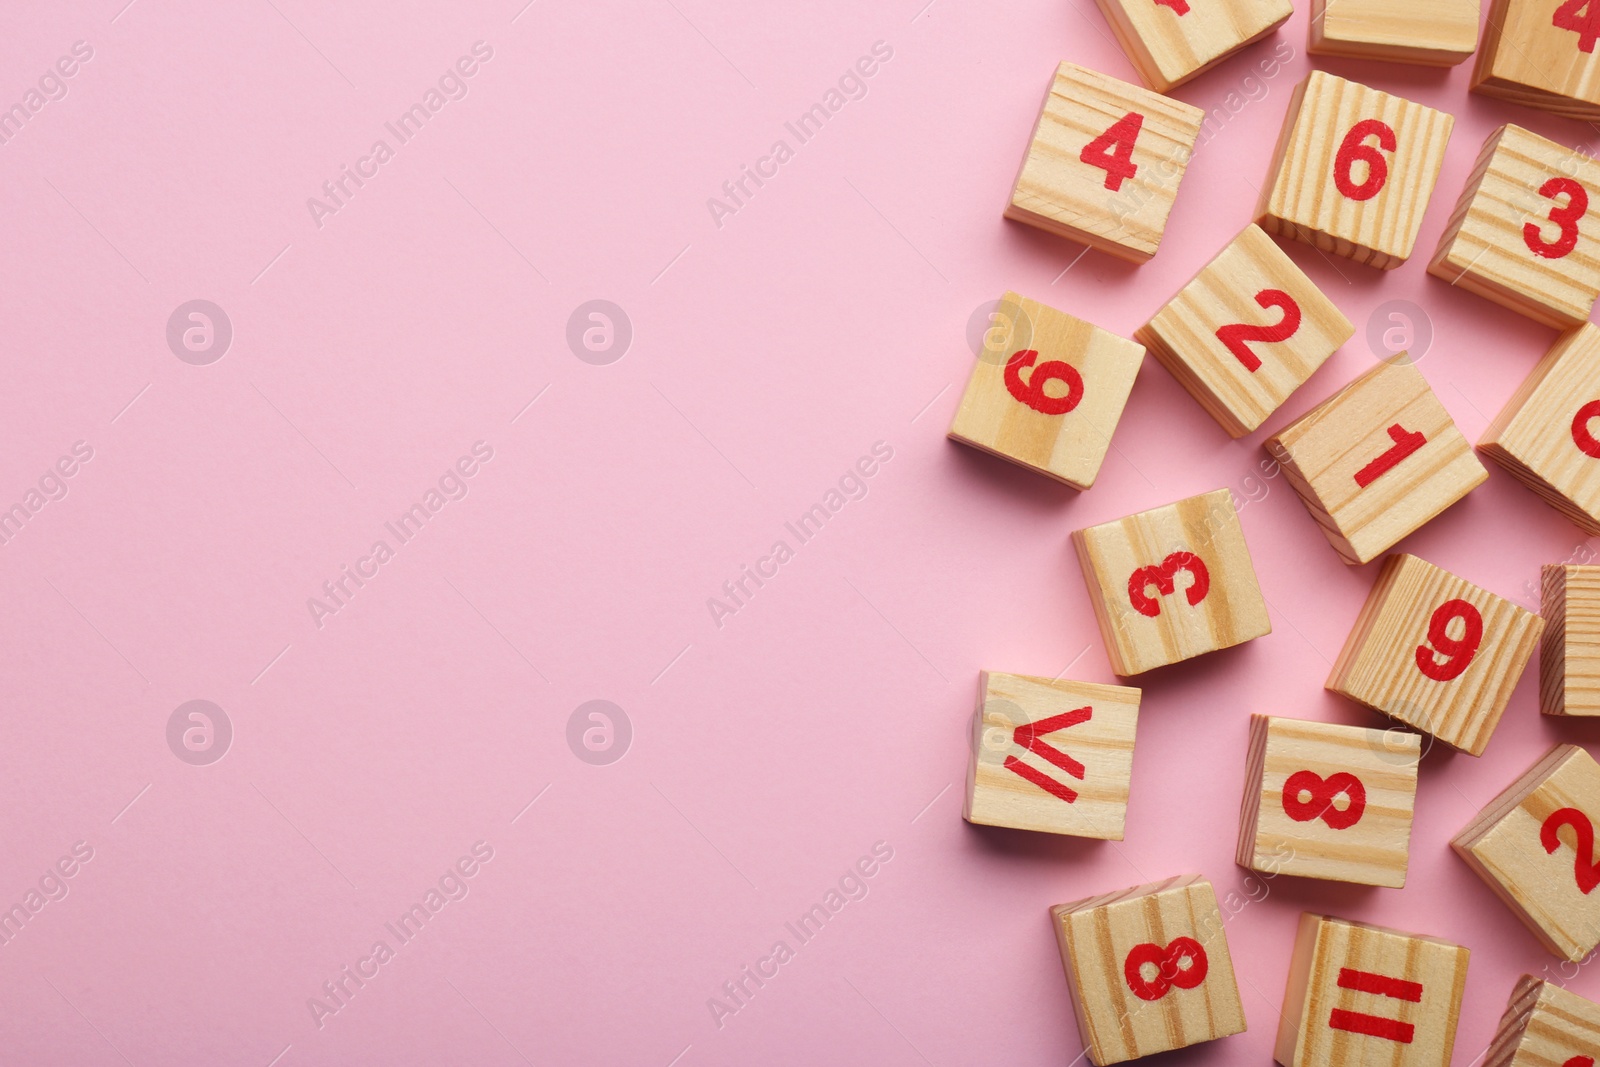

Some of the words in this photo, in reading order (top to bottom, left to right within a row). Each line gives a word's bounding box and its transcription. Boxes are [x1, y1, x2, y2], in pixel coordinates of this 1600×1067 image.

[1552, 0, 1600, 54] 4
[1080, 113, 1143, 191] 4
[1334, 119, 1396, 202] 6
[1523, 177, 1588, 258] 3
[1216, 289, 1300, 372] 2
[1354, 424, 1427, 488] 1
[1128, 552, 1210, 618] 3
[1282, 770, 1366, 830] 8
[1540, 808, 1600, 895] 2
[1124, 936, 1208, 1000] 8
